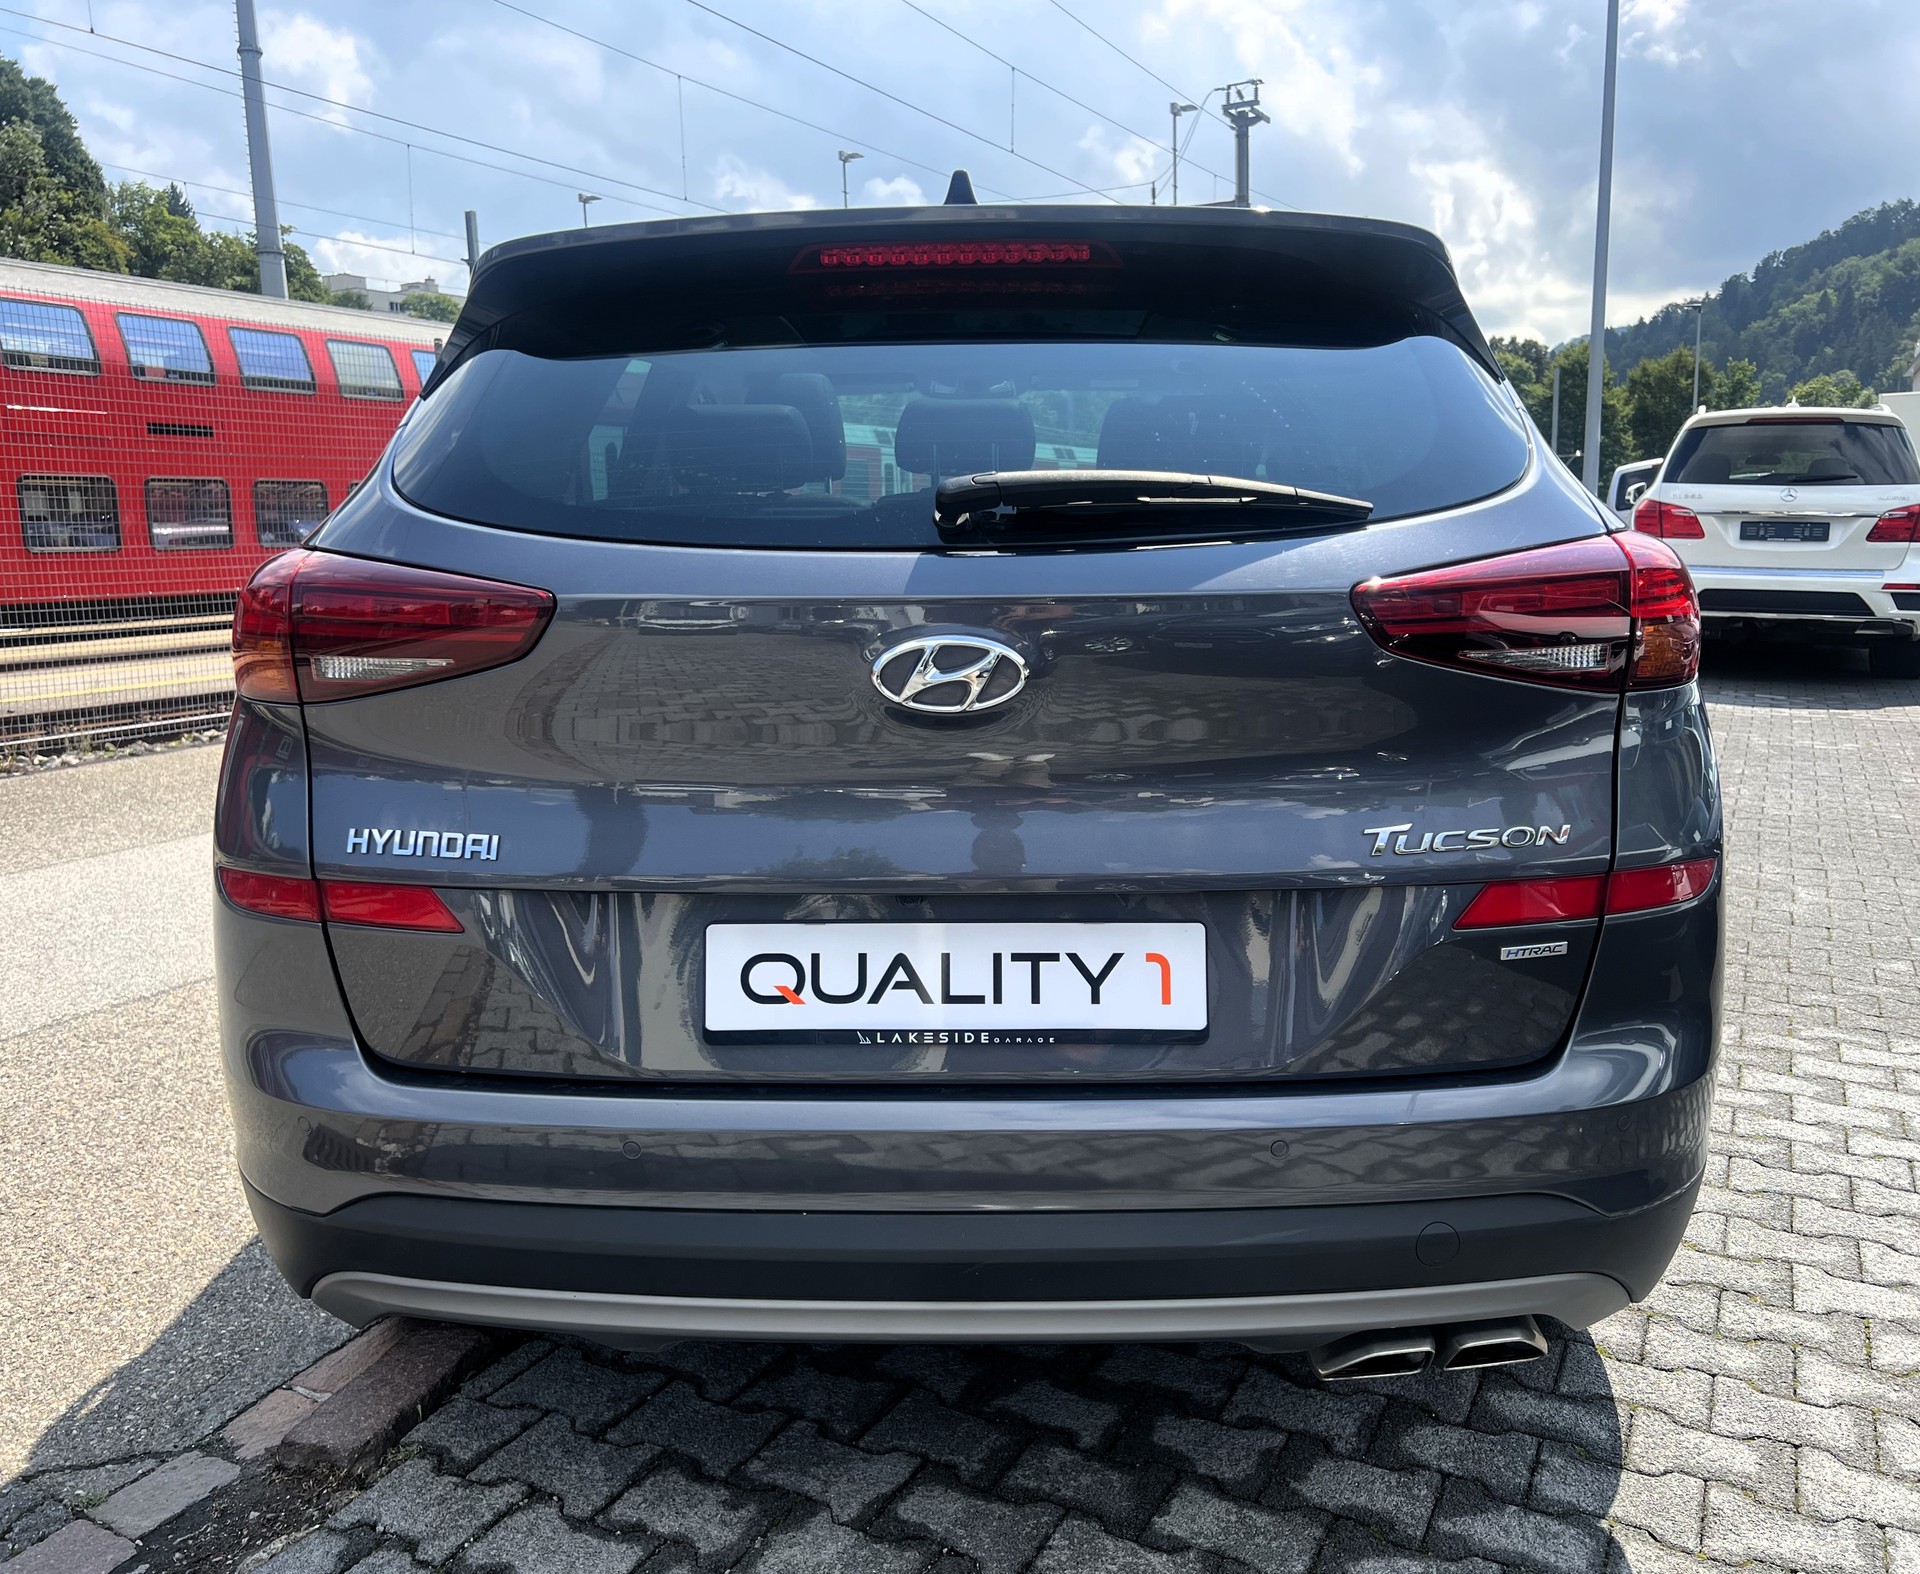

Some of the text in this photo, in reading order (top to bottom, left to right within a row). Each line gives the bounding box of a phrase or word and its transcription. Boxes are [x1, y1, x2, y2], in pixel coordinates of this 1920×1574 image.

[346, 828, 500, 861] HYUNDAI
[1363, 823, 1572, 857] TUCSON
[1505, 944, 1564, 959] HTRAC
[740, 952, 1172, 1006] QUALITY 1
[876, 1032, 990, 1044] LAKESIDE
